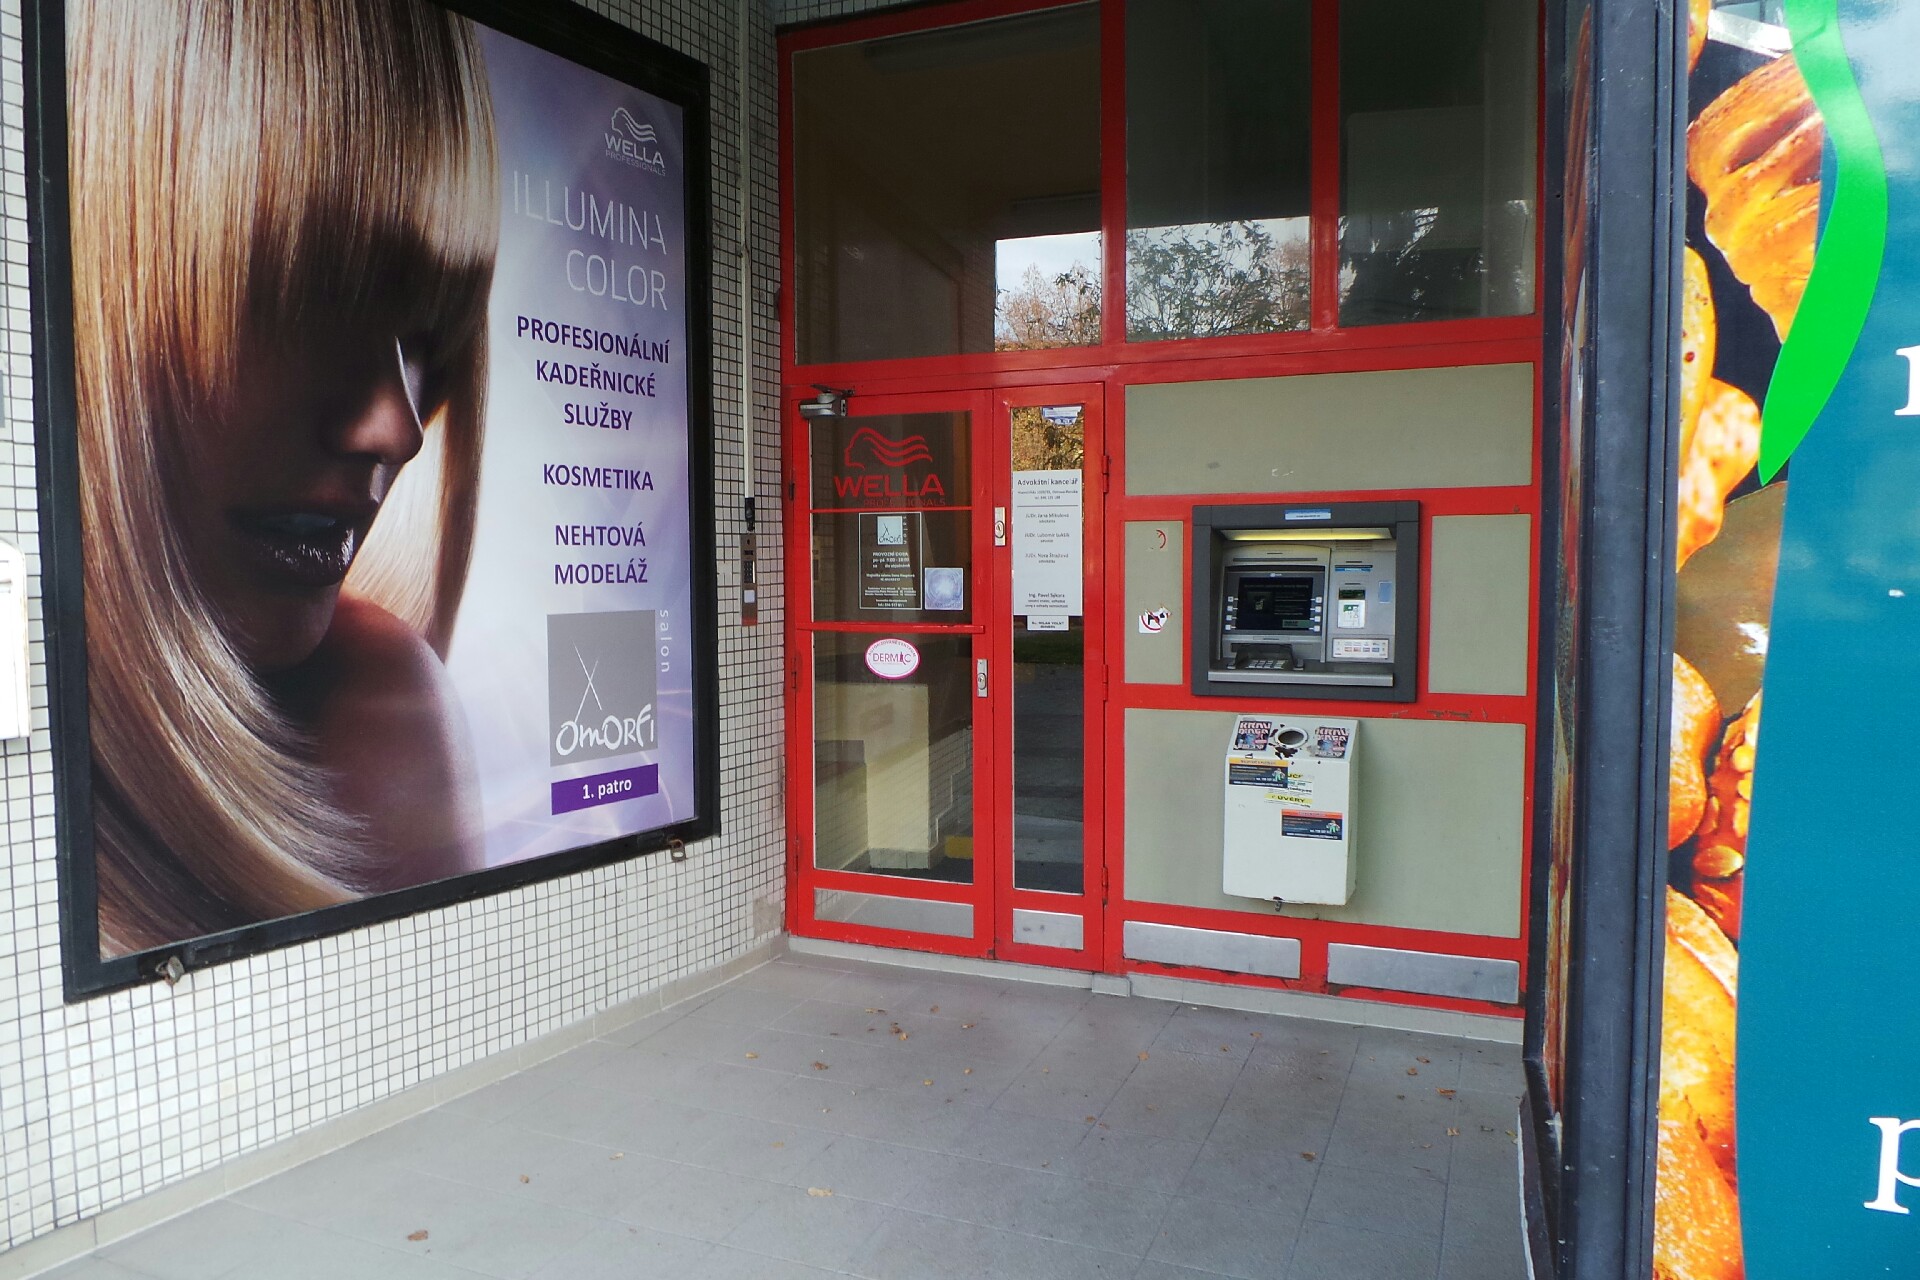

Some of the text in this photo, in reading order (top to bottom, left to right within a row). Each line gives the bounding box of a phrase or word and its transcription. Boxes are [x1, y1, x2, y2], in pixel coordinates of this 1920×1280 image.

[605, 133, 665, 168] WELLA
[605, 150, 666, 176] PROFESSIONALS
[514, 171, 667, 255] ILLUMINA
[566, 250, 667, 311] COLOR
[517, 315, 670, 364] PROFESIONÁLNÍ
[536, 359, 656, 398] KADEŘNICKÉ
[563, 402, 633, 431] SLUŽBY
[543, 463, 654, 491] KOSMETIKA
[833, 473, 945, 498] WELLA
[555, 522, 646, 547] NEHTOVÁ
[554, 557, 648, 585] MODELÁŽ
[659, 609, 672, 673] salon
[582, 778, 632, 800] 1. patro
